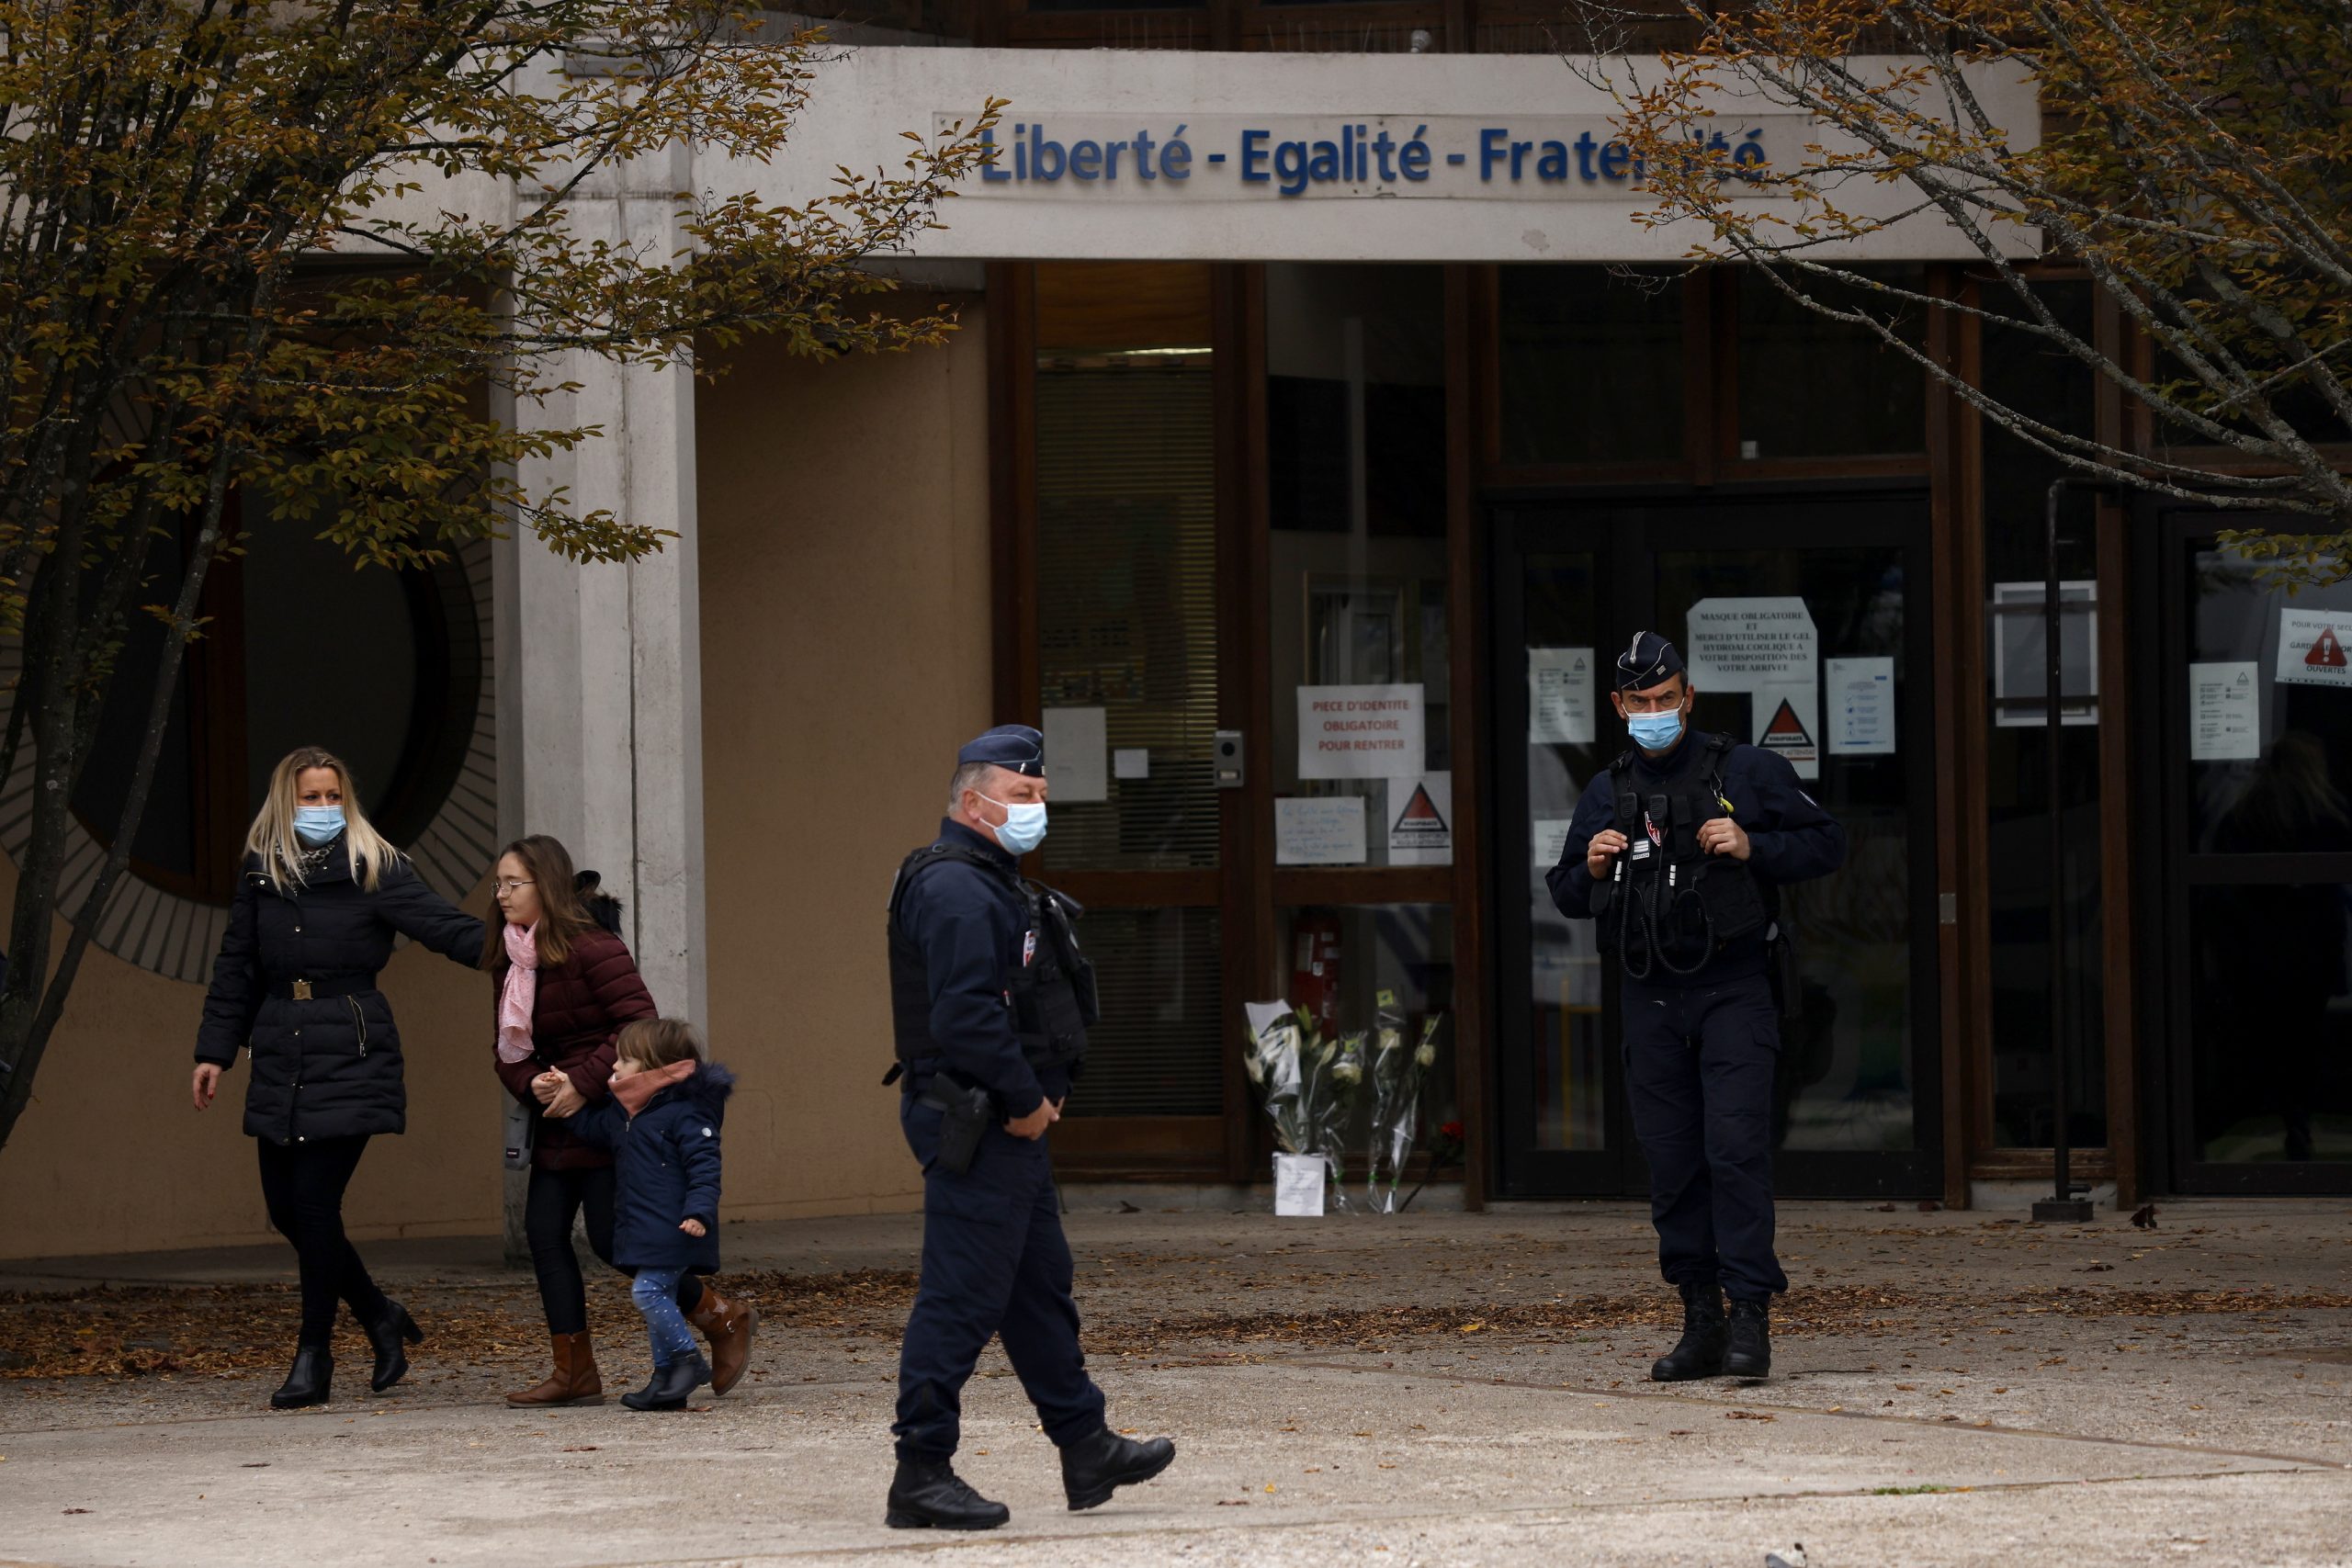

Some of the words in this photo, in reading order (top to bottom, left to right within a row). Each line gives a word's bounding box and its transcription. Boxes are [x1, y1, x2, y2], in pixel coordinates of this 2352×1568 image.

[980, 123, 1193, 181] Liberté
[1241, 124, 1431, 196] Egalité
[1700, 613, 1739, 621] MASQUE
[1741, 612, 1804, 620] OBLIGATOIRE
[1695, 633, 1724, 641] MERCI
[1725, 633, 1777, 641] D'UTILISER
[1792, 632, 1812, 640] GEL
[1702, 643, 1793, 651] HYDROALCOOLIQUE
[1731, 653, 1788, 661] DISPOSITION
[1312, 701, 1343, 711] PIECE
[1323, 720, 1399, 731] OBLIGATOIRE
[1318, 740, 1351, 751] POUR
[1353, 739, 1405, 750] RENTRER
